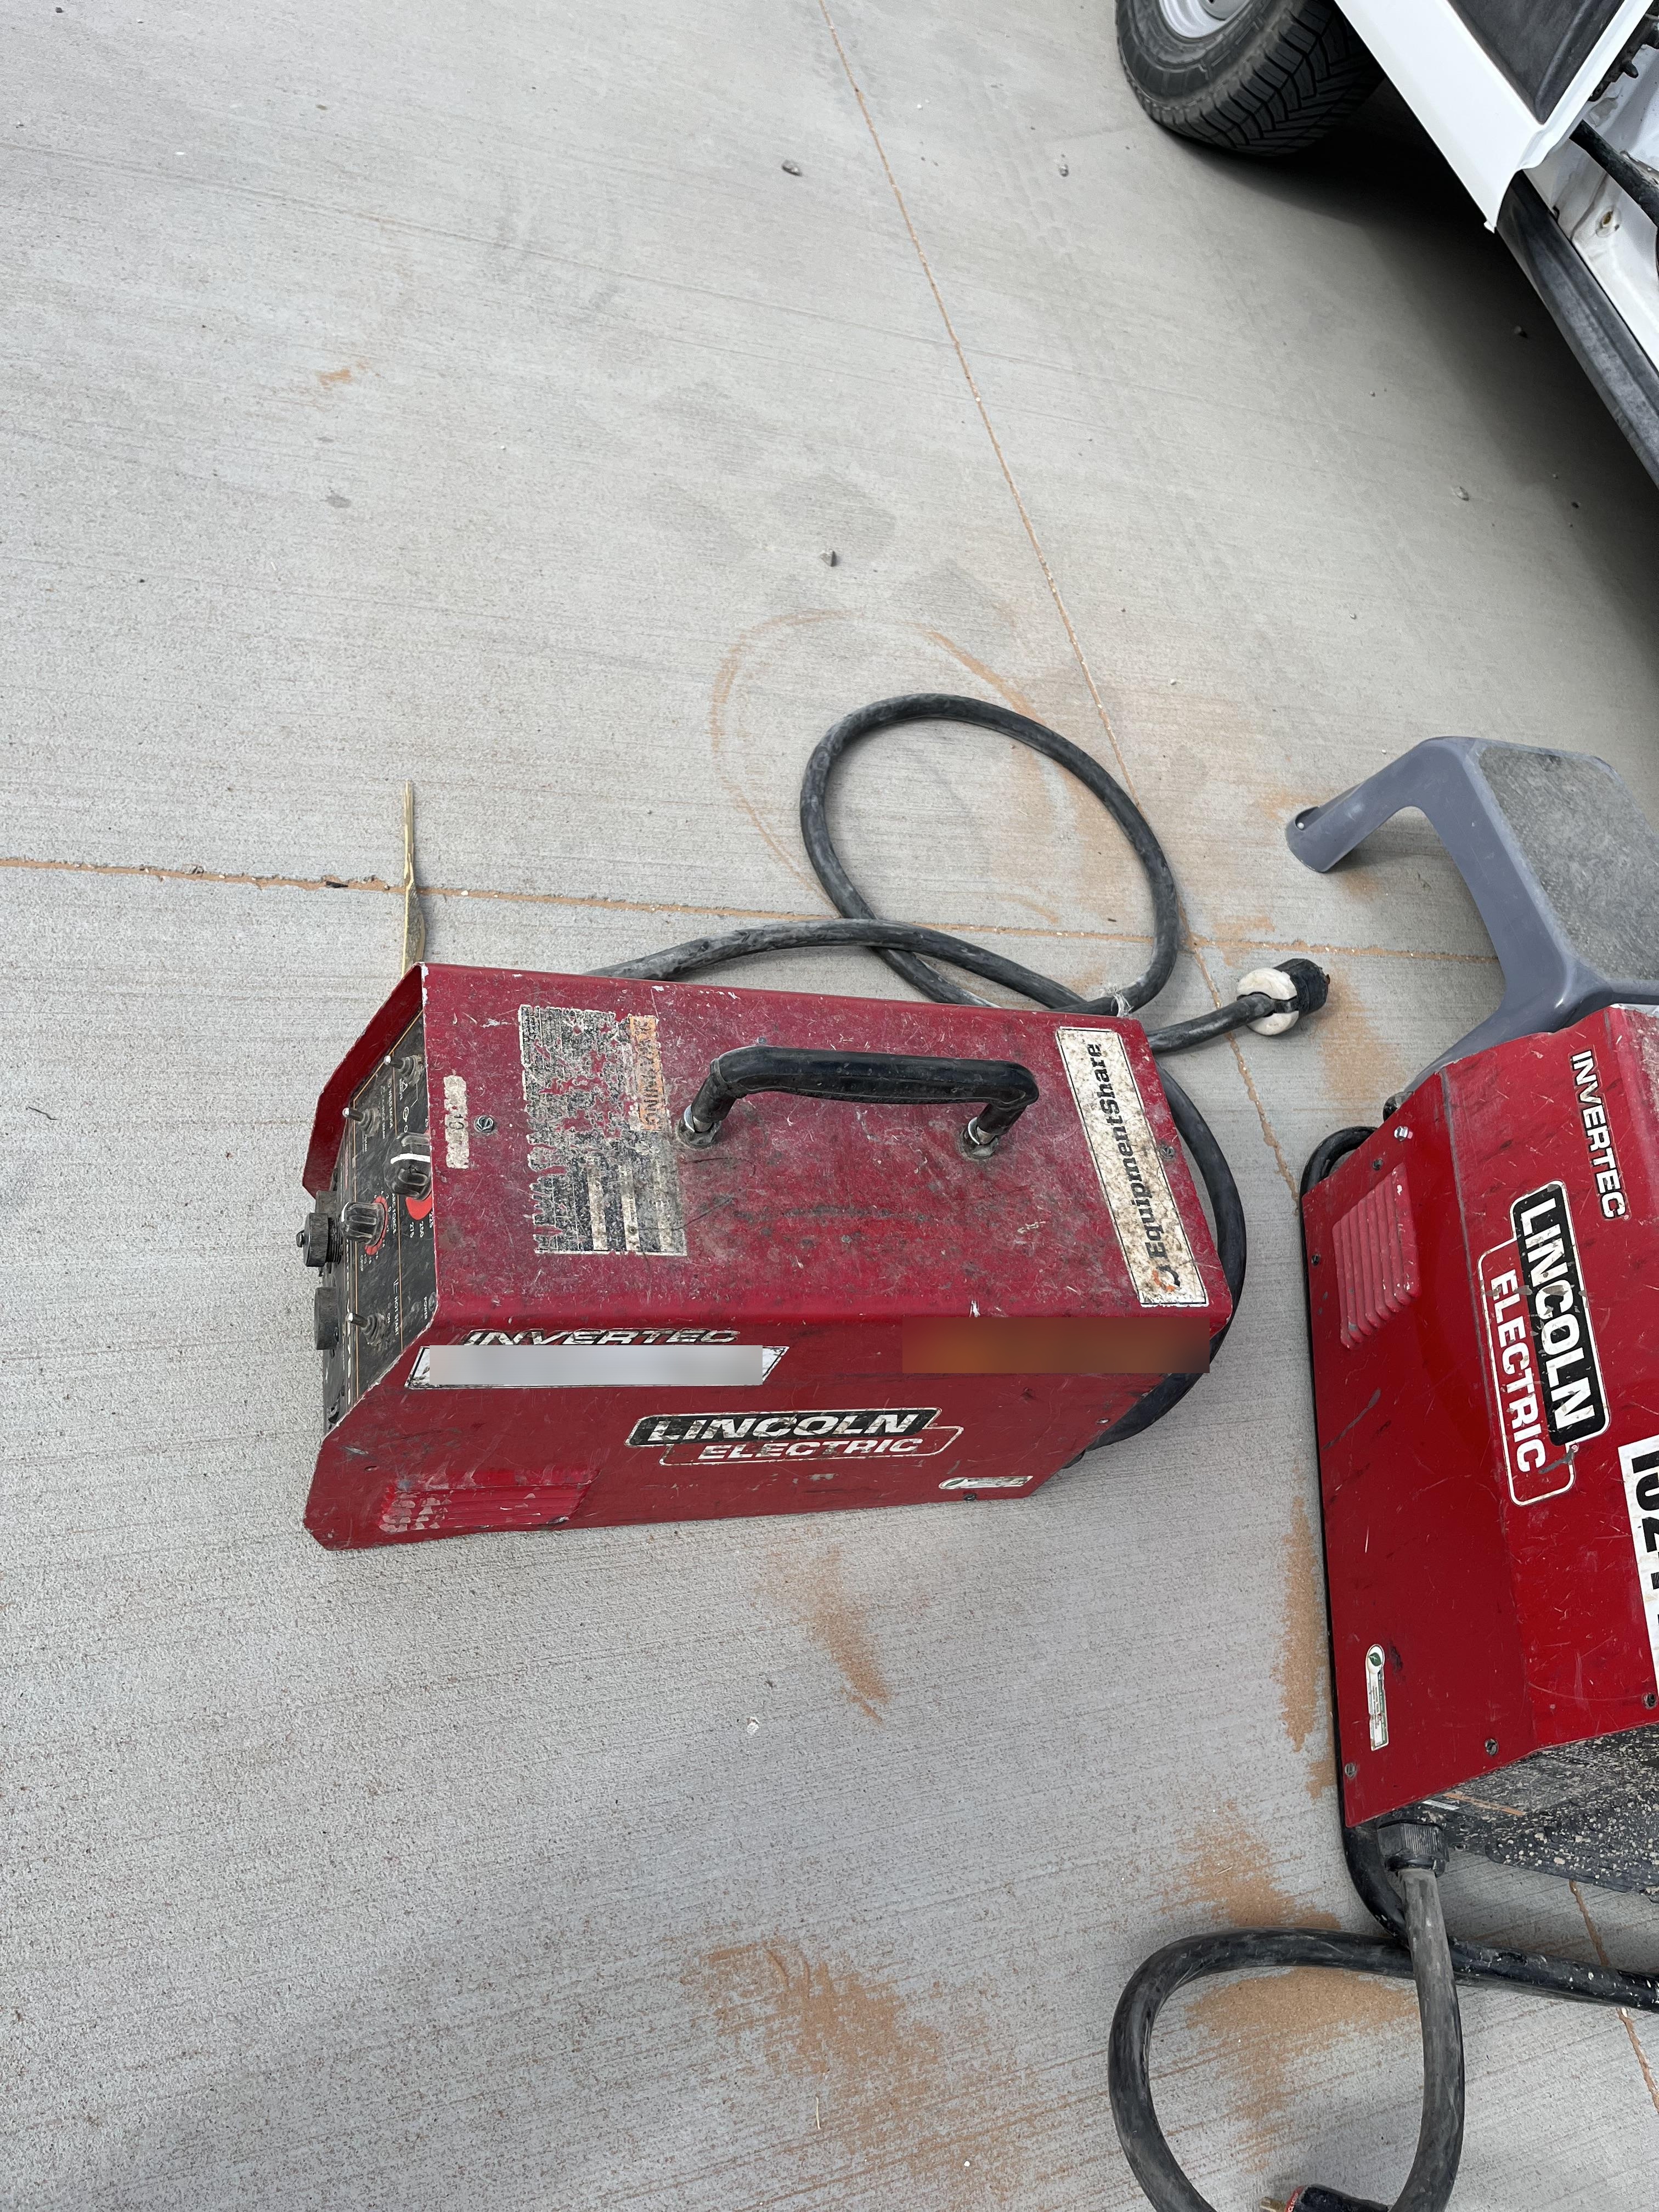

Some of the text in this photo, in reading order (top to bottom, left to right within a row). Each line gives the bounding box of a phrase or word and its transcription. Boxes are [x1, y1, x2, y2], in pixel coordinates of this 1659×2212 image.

[1086, 1043, 1169, 1260] EquipmentShare
[1571, 1050, 1626, 1220] INVERTEC
[462, 1329, 742, 1346] INVERTEC
[1490, 1268, 1544, 1474] ELECTRIC
[1519, 1197, 1596, 1434] LINCOLN
[646, 1413, 920, 1443] LINCOLN
[697, 1437, 924, 1460] ELECTRIC
